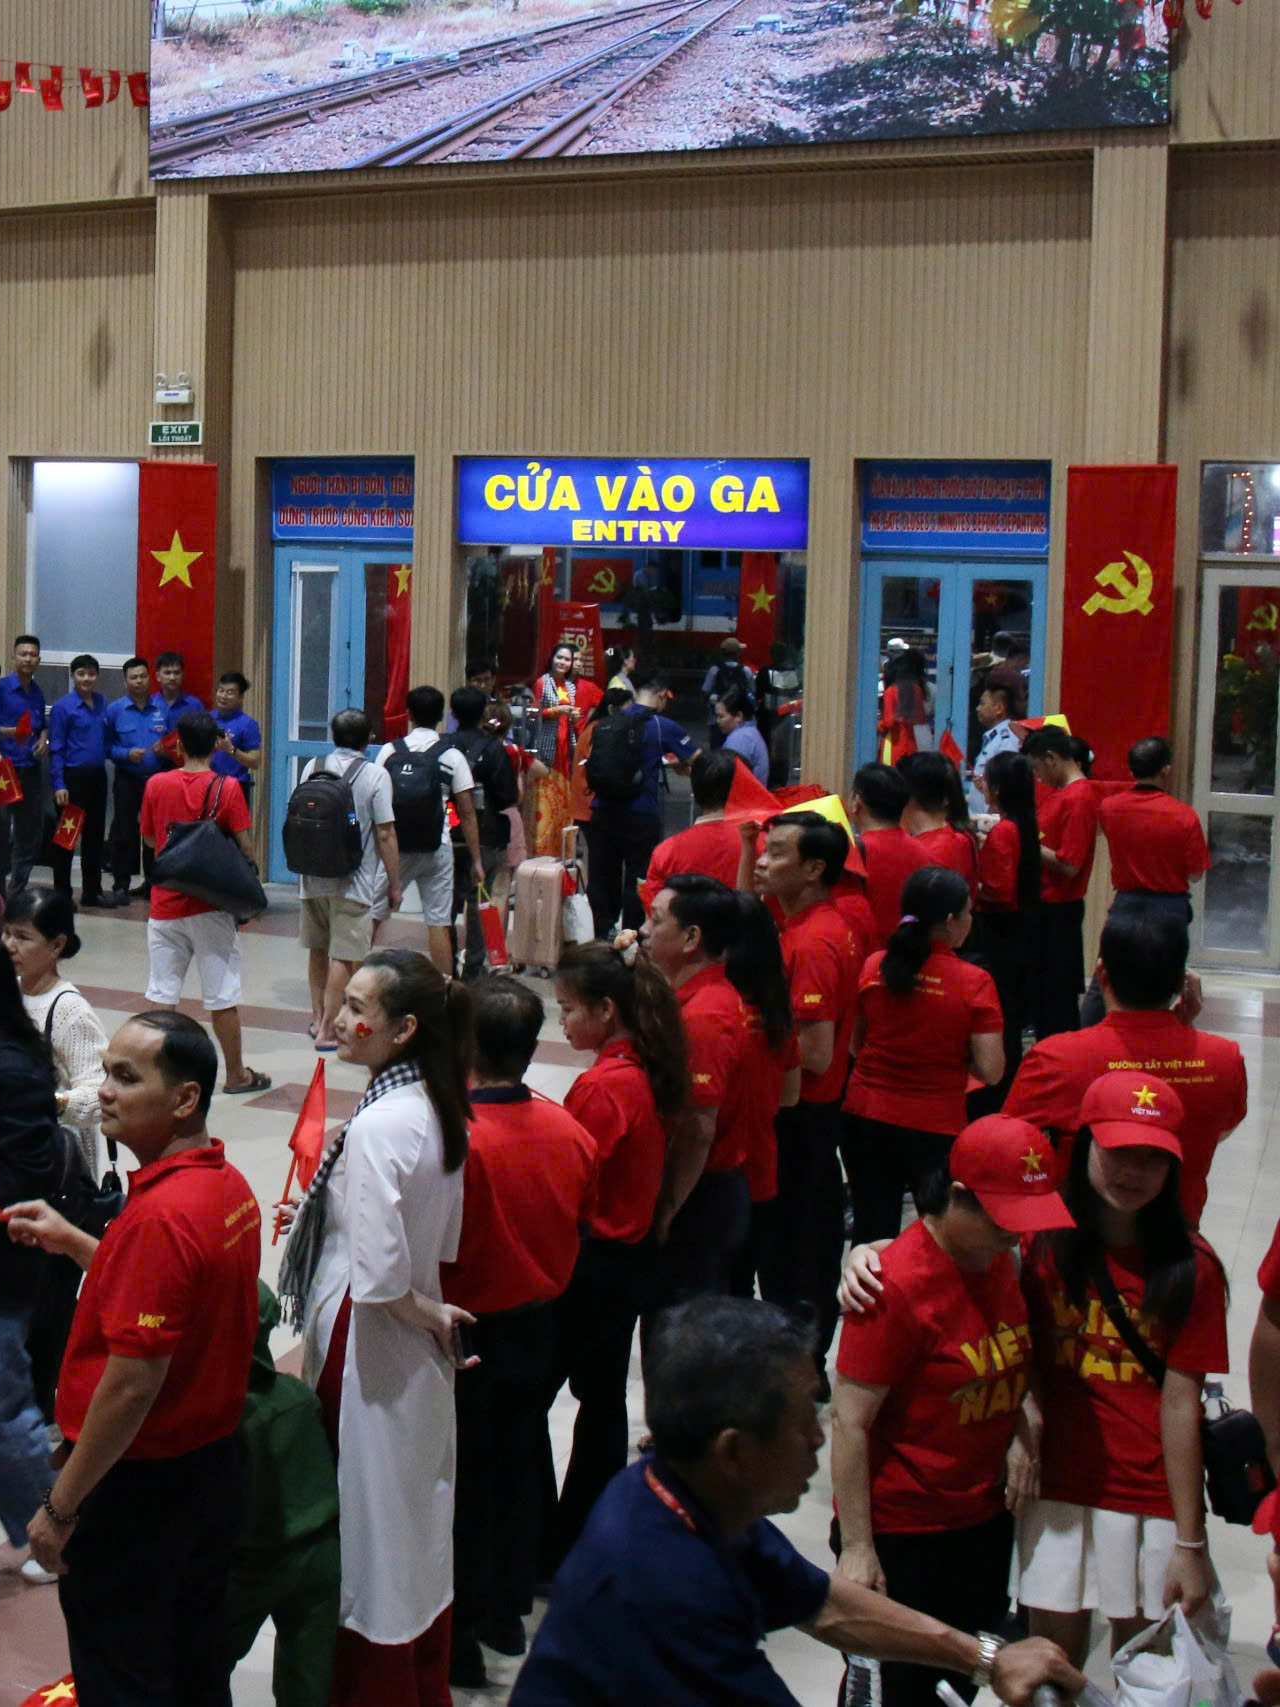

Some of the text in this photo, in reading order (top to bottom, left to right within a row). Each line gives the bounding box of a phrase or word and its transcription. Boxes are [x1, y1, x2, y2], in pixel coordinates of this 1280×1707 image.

[162, 425, 190, 434] EXIT
[483, 461, 781, 513] CỬA VÀO GA
[571, 519, 686, 543] ENTRY
[1164, 1059, 1182, 1072] VIỆT
[1184, 1059, 1206, 1069] NAM
